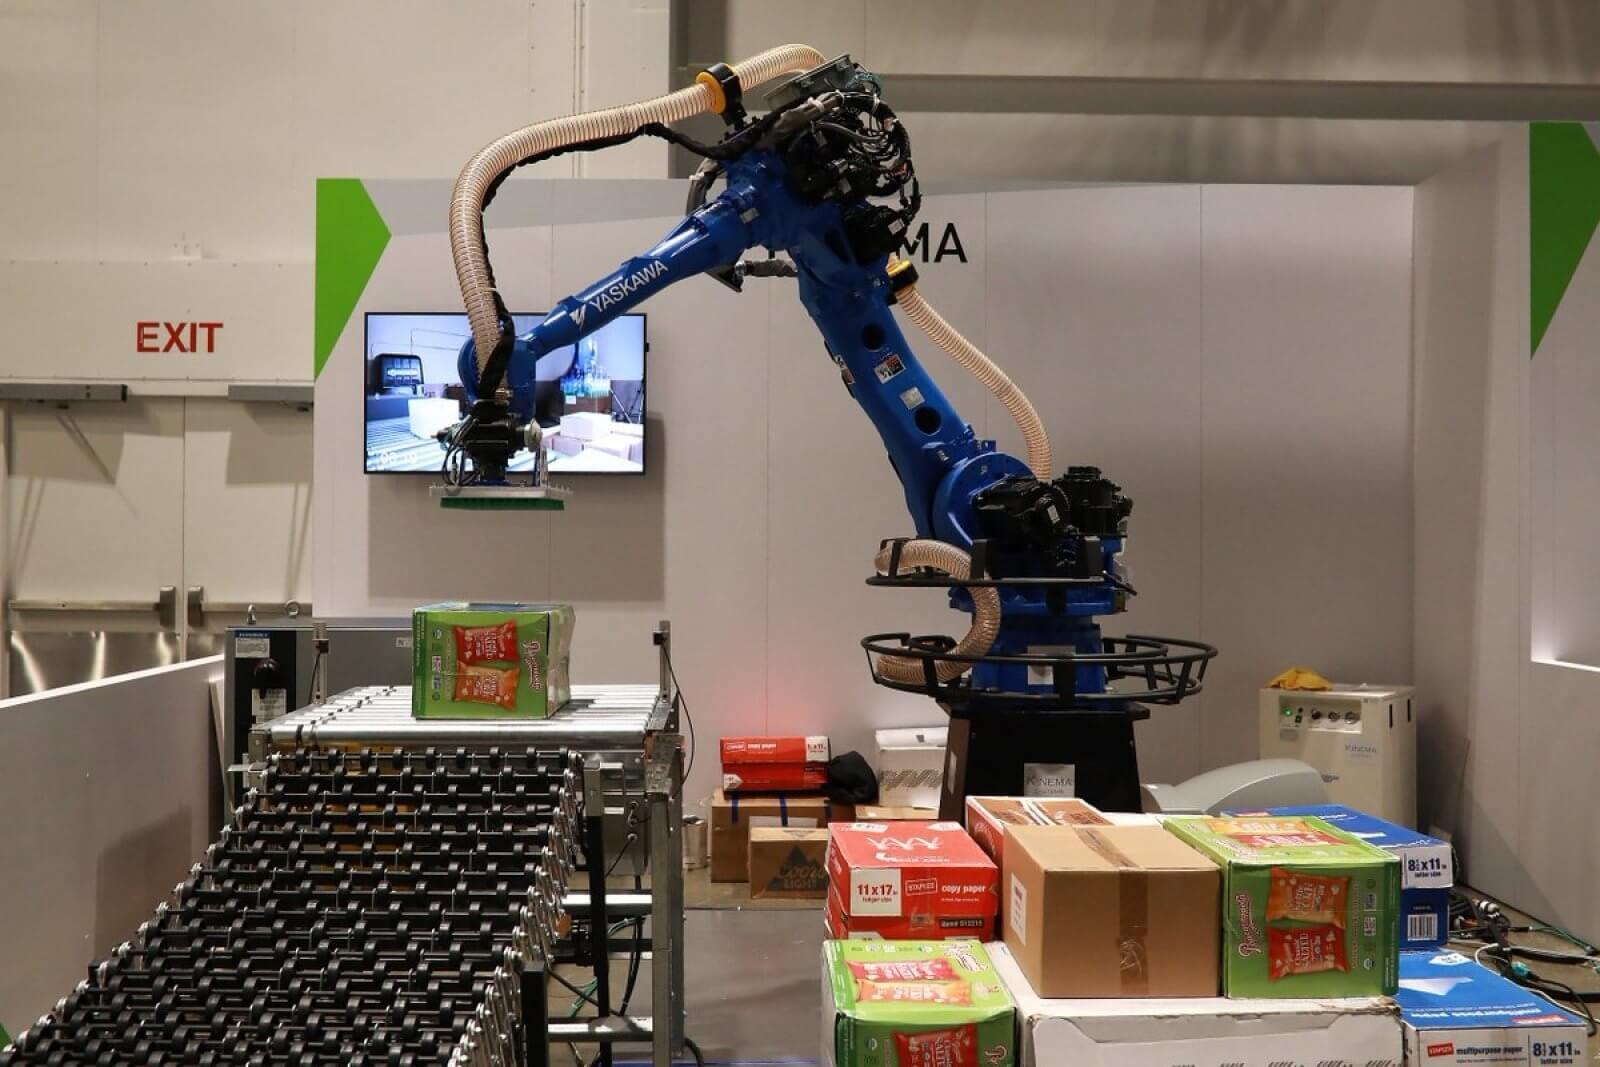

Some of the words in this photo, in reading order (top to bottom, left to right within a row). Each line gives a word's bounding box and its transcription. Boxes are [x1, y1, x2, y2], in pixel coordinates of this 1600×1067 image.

[588, 260, 669, 312] YASKAWA
[137, 322, 224, 352] EXIT
[1026, 775, 1073, 786] KNEMA
[908, 882, 935, 892] STAPLES
[941, 885, 961, 895] copy
[963, 885, 986, 894] paper
[1456, 1046, 1501, 1056] multipurpose
[1503, 1046, 1524, 1056] paper
